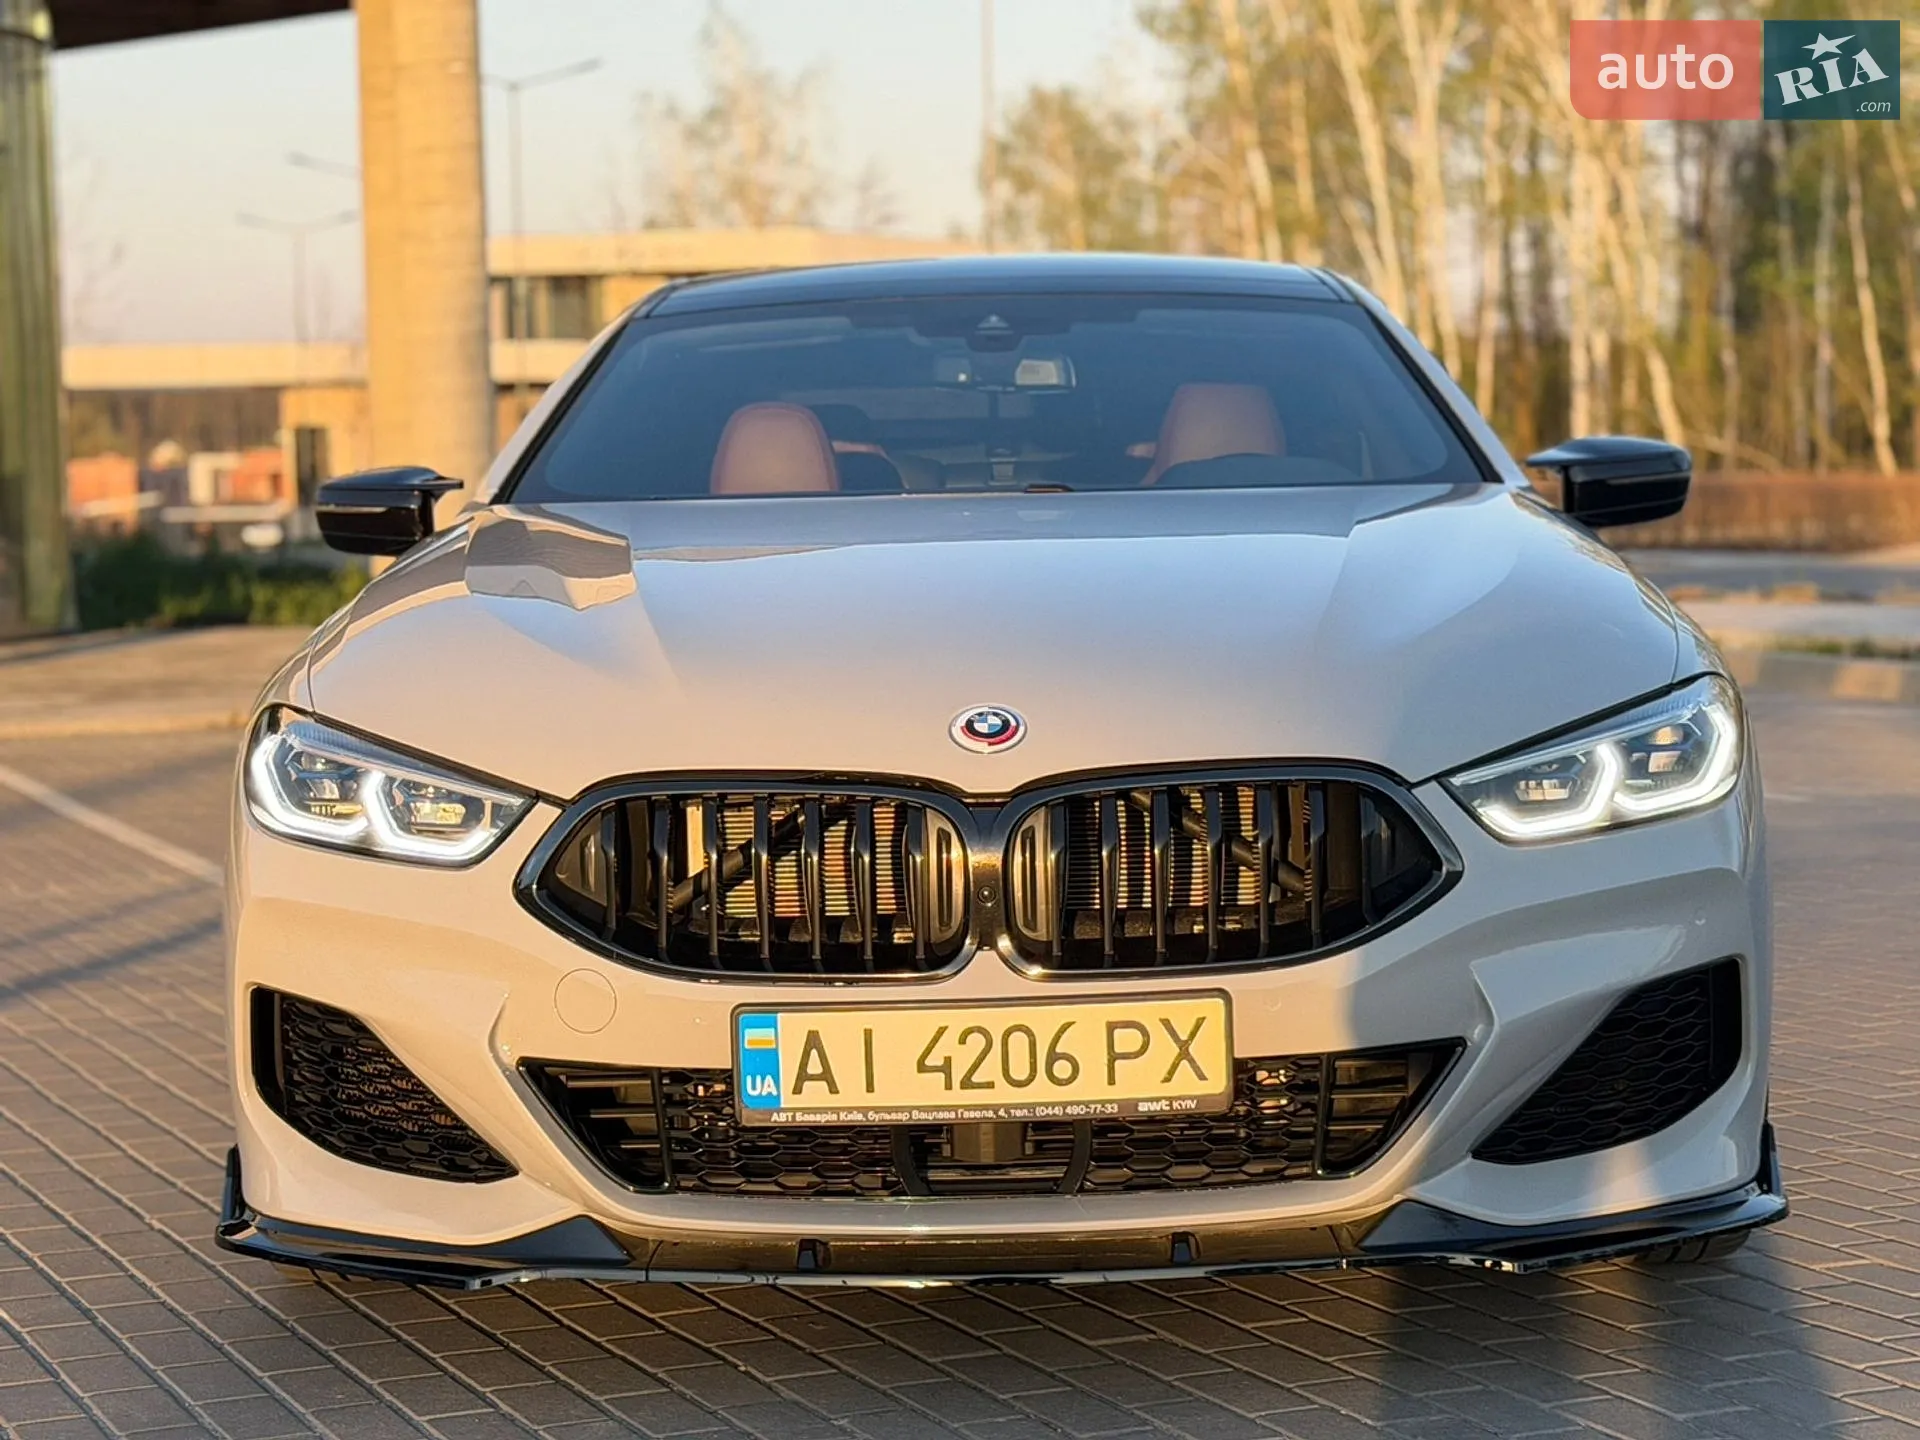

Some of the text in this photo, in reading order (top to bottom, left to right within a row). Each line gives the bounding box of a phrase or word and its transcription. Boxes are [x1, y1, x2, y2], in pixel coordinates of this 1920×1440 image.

[916, 1020, 1080, 1092] 4206
[1105, 1015, 1209, 1086] PX
[746, 1074, 778, 1097] UA
[1035, 1105, 1063, 1116] (044)
[1064, 1103, 1117, 1115] 490-77-33
[1172, 1099, 1197, 1110] KYIV
